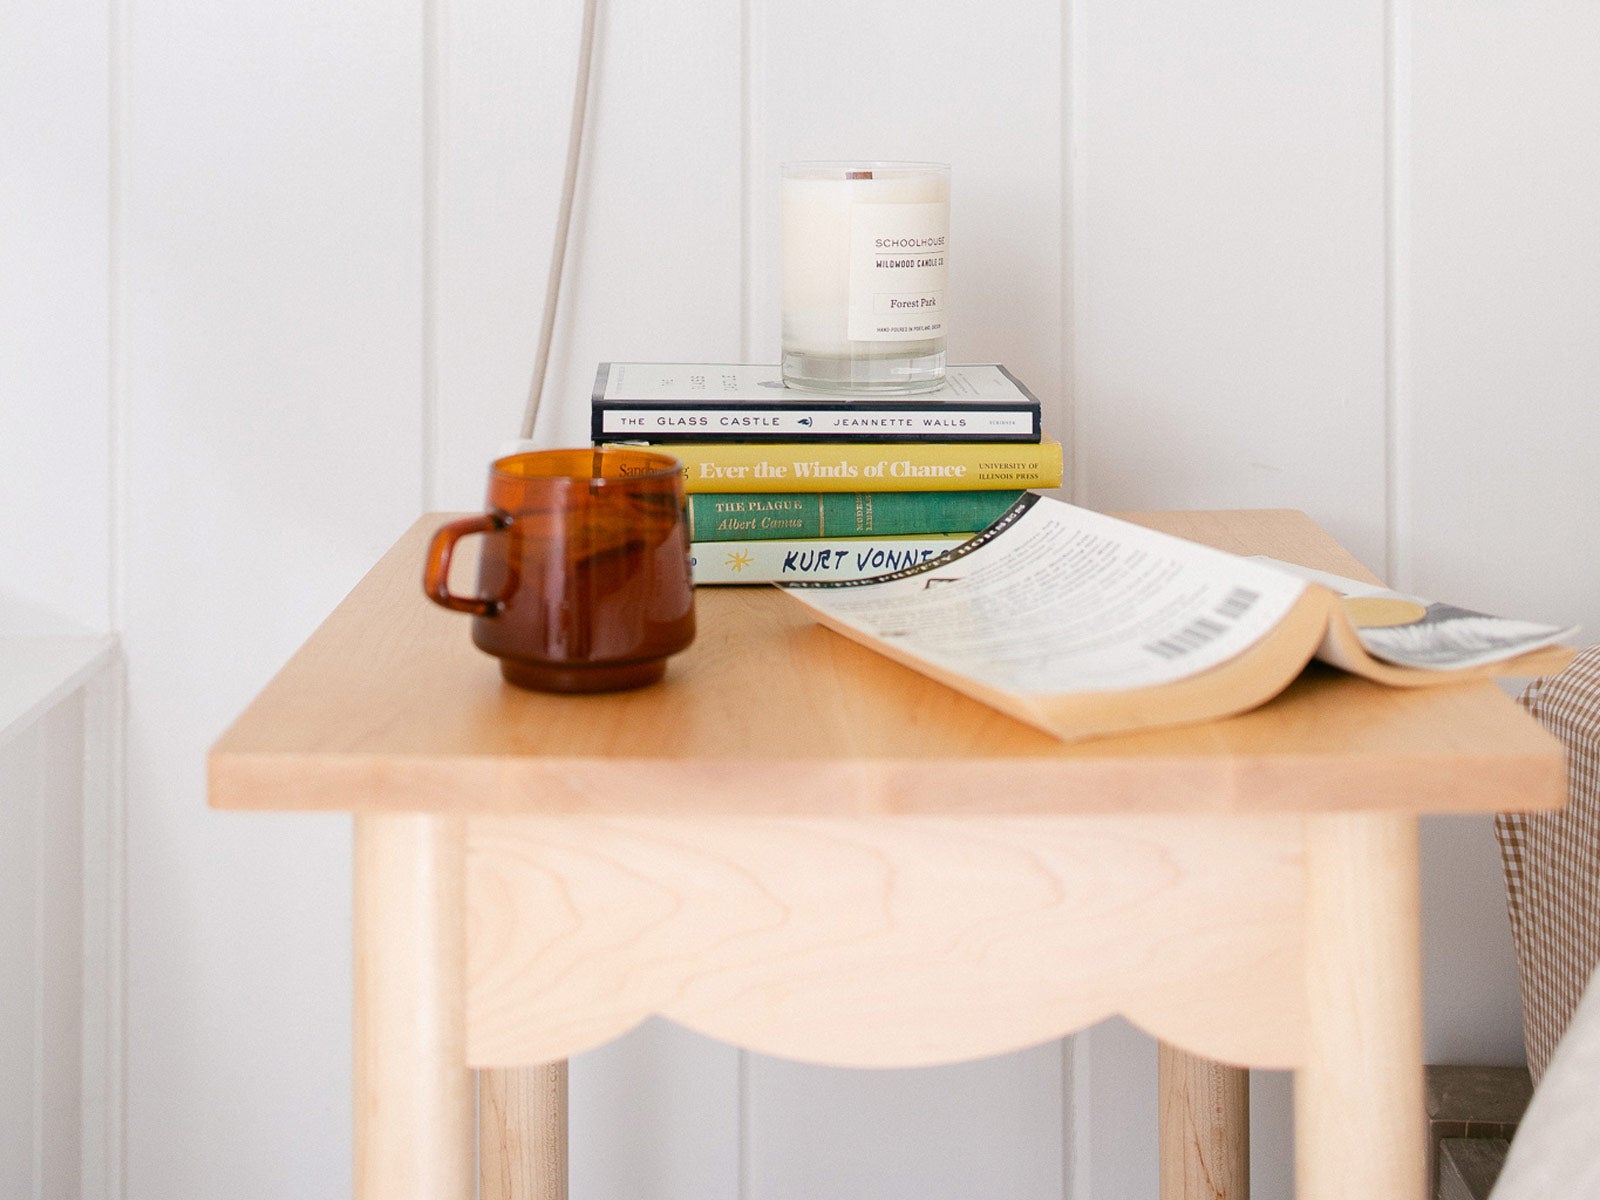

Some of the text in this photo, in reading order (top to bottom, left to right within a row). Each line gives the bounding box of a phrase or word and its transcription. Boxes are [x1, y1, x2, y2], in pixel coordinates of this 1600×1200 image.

[875, 236, 945, 248] SCHOOLHOUSE
[876, 259, 915, 268] WILDWOOD
[917, 258, 938, 268] CANDLE
[890, 297, 937, 308] Forest Park
[620, 416, 781, 427] THE GLASS CASTLE
[832, 417, 967, 427] JEANNETTE WALLS
[700, 460, 967, 480] Ever the Winds of Chance
[978, 462, 1039, 470] UNIVERSITY OF
[978, 472, 1040, 480] ILLINOIS PRESS
[715, 501, 803, 513] THE PLAGUE
[717, 515, 803, 531] Albert Camus
[957, 503, 1026, 555] HORSES
[782, 548, 850, 573] KURT
